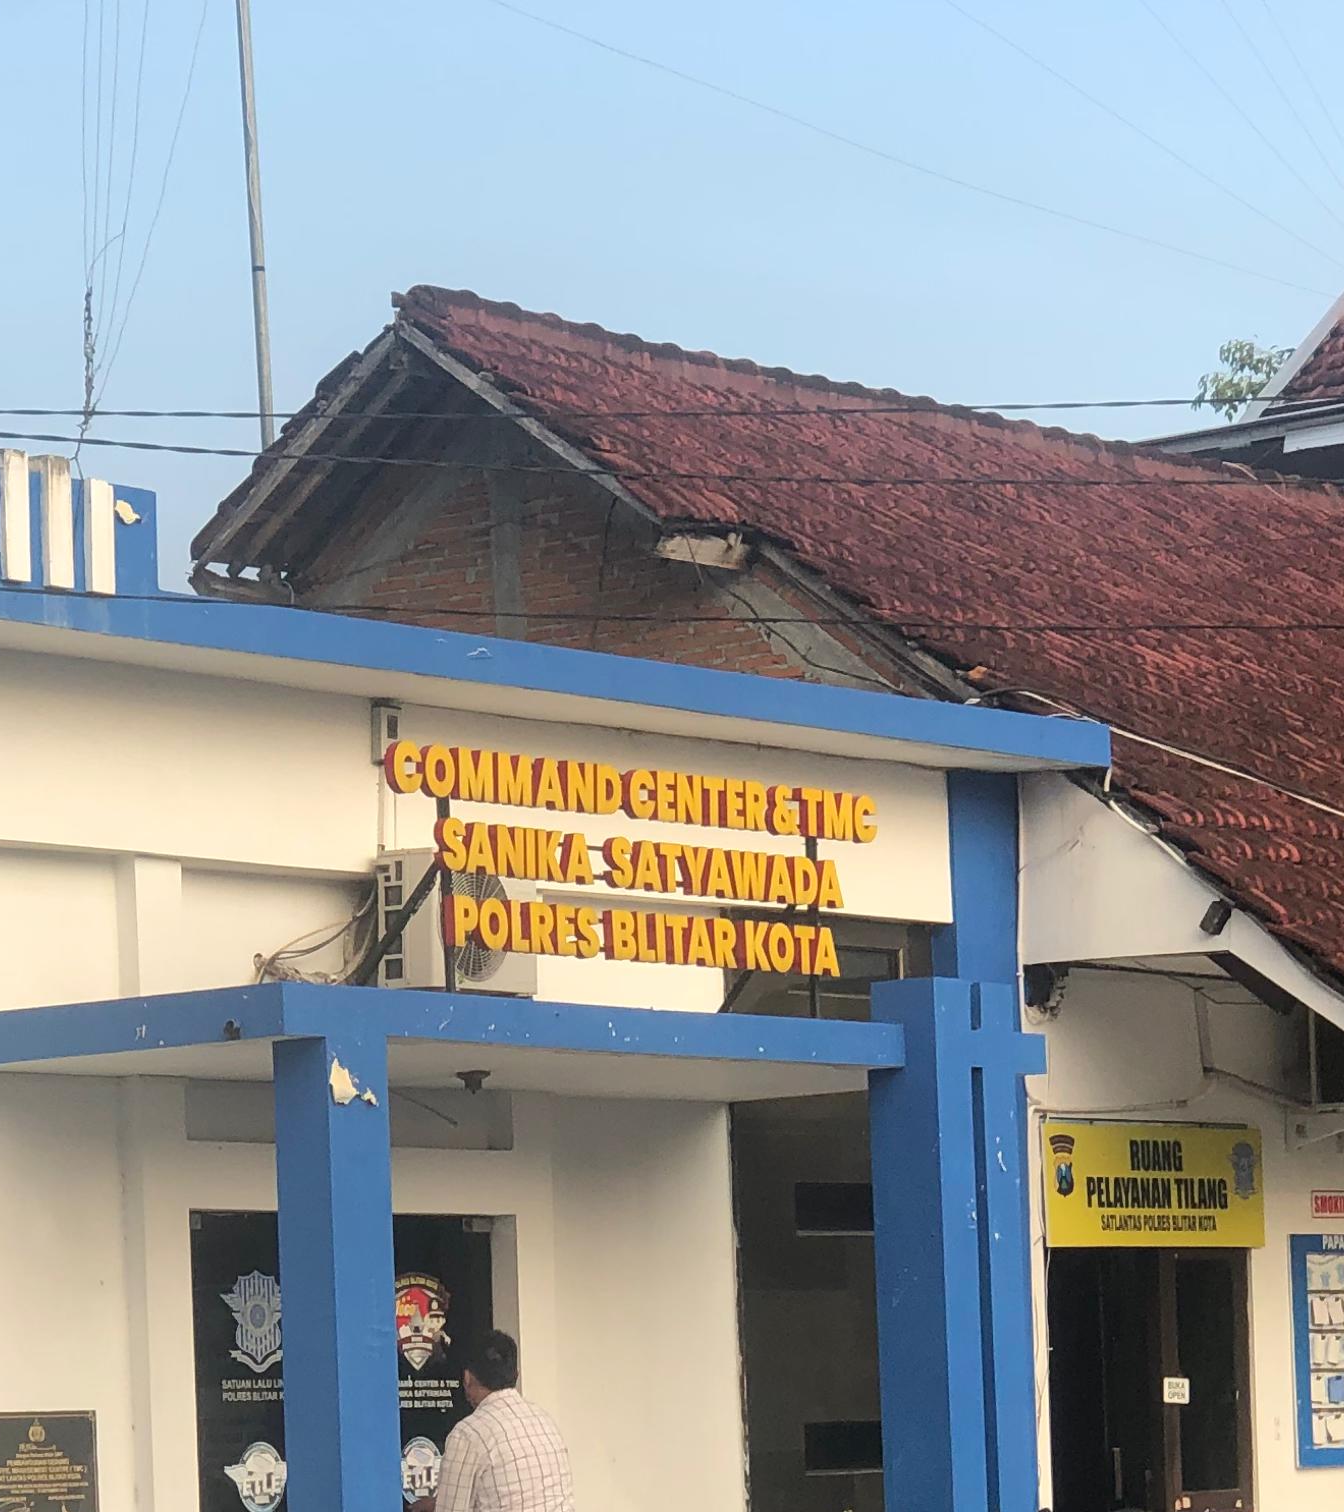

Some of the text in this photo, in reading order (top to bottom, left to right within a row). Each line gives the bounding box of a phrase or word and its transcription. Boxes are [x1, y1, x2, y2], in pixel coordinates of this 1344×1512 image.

[384, 740, 878, 843] COMMAND CENTER & TMC
[434, 817, 845, 909] SANIKA SATYAWADA
[444, 895, 840, 977] POLRES BLITAR KOTA
[1129, 1140, 1183, 1172] RUANG
[1086, 1176, 1228, 1209] PELAYANAN TILANG
[1101, 1214, 1217, 1231] SATLANTAS POLRES BLITAR KOTA
[1168, 1391, 1185, 1399] OPEN
